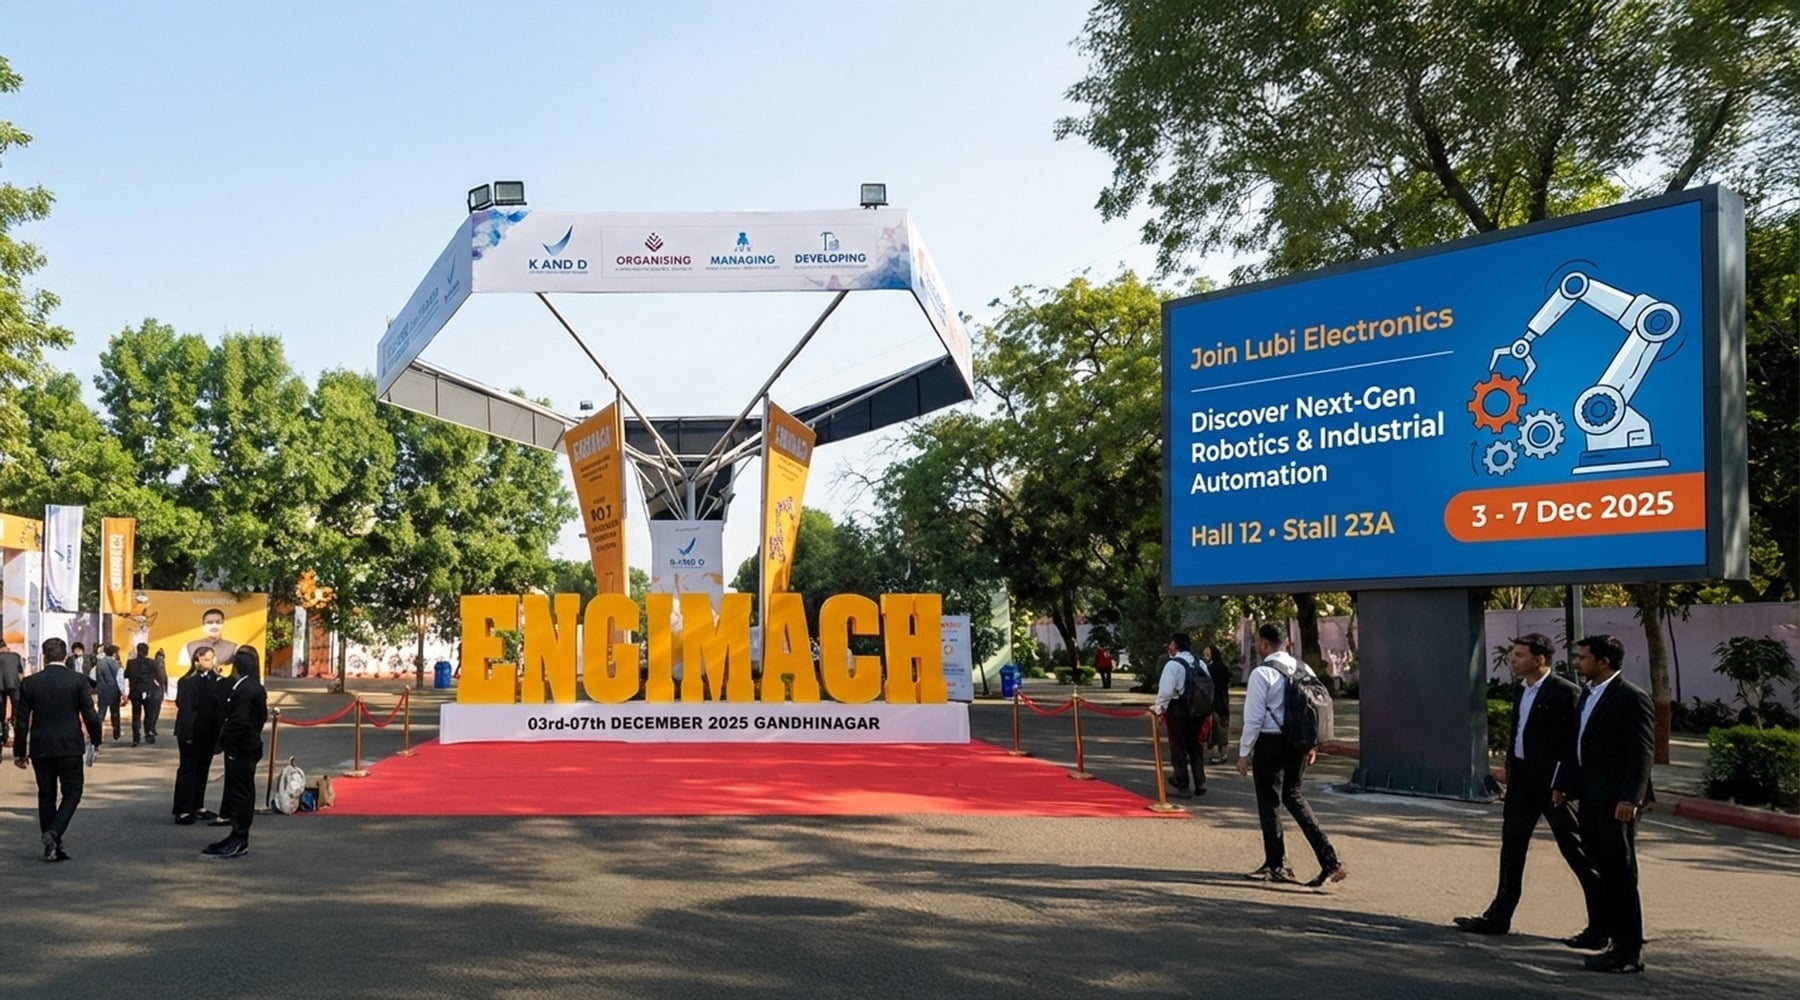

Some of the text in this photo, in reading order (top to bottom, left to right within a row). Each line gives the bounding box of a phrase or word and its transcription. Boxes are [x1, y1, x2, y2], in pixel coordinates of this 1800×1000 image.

[529, 259, 587, 269] K AND D
[616, 255, 691, 265] ORGANISING
[710, 255, 776, 265] MANAGING
[795, 253, 866, 264] DEVELOPING
[1190, 306, 1454, 370] Join Lubi Electronics
[1191, 386, 1415, 433] Discover Next-Gen
[1191, 411, 1444, 463] Robotics & Industrial
[1190, 461, 1328, 495] Automation
[1471, 505, 1487, 527] 3
[1512, 502, 1528, 524] 7
[1537, 500, 1593, 523] Dec
[1600, 490, 1674, 519] 2025
[1191, 522, 1233, 547] Hall
[1240, 521, 1262, 543] 12
[1283, 515, 1337, 541] Stall
[1344, 511, 1394, 537] 23A
[457, 593, 948, 705] ENGIMACH
[527, 716, 880, 731] 03rd-07th DECEMBER 2025 GANDHINAGAR
